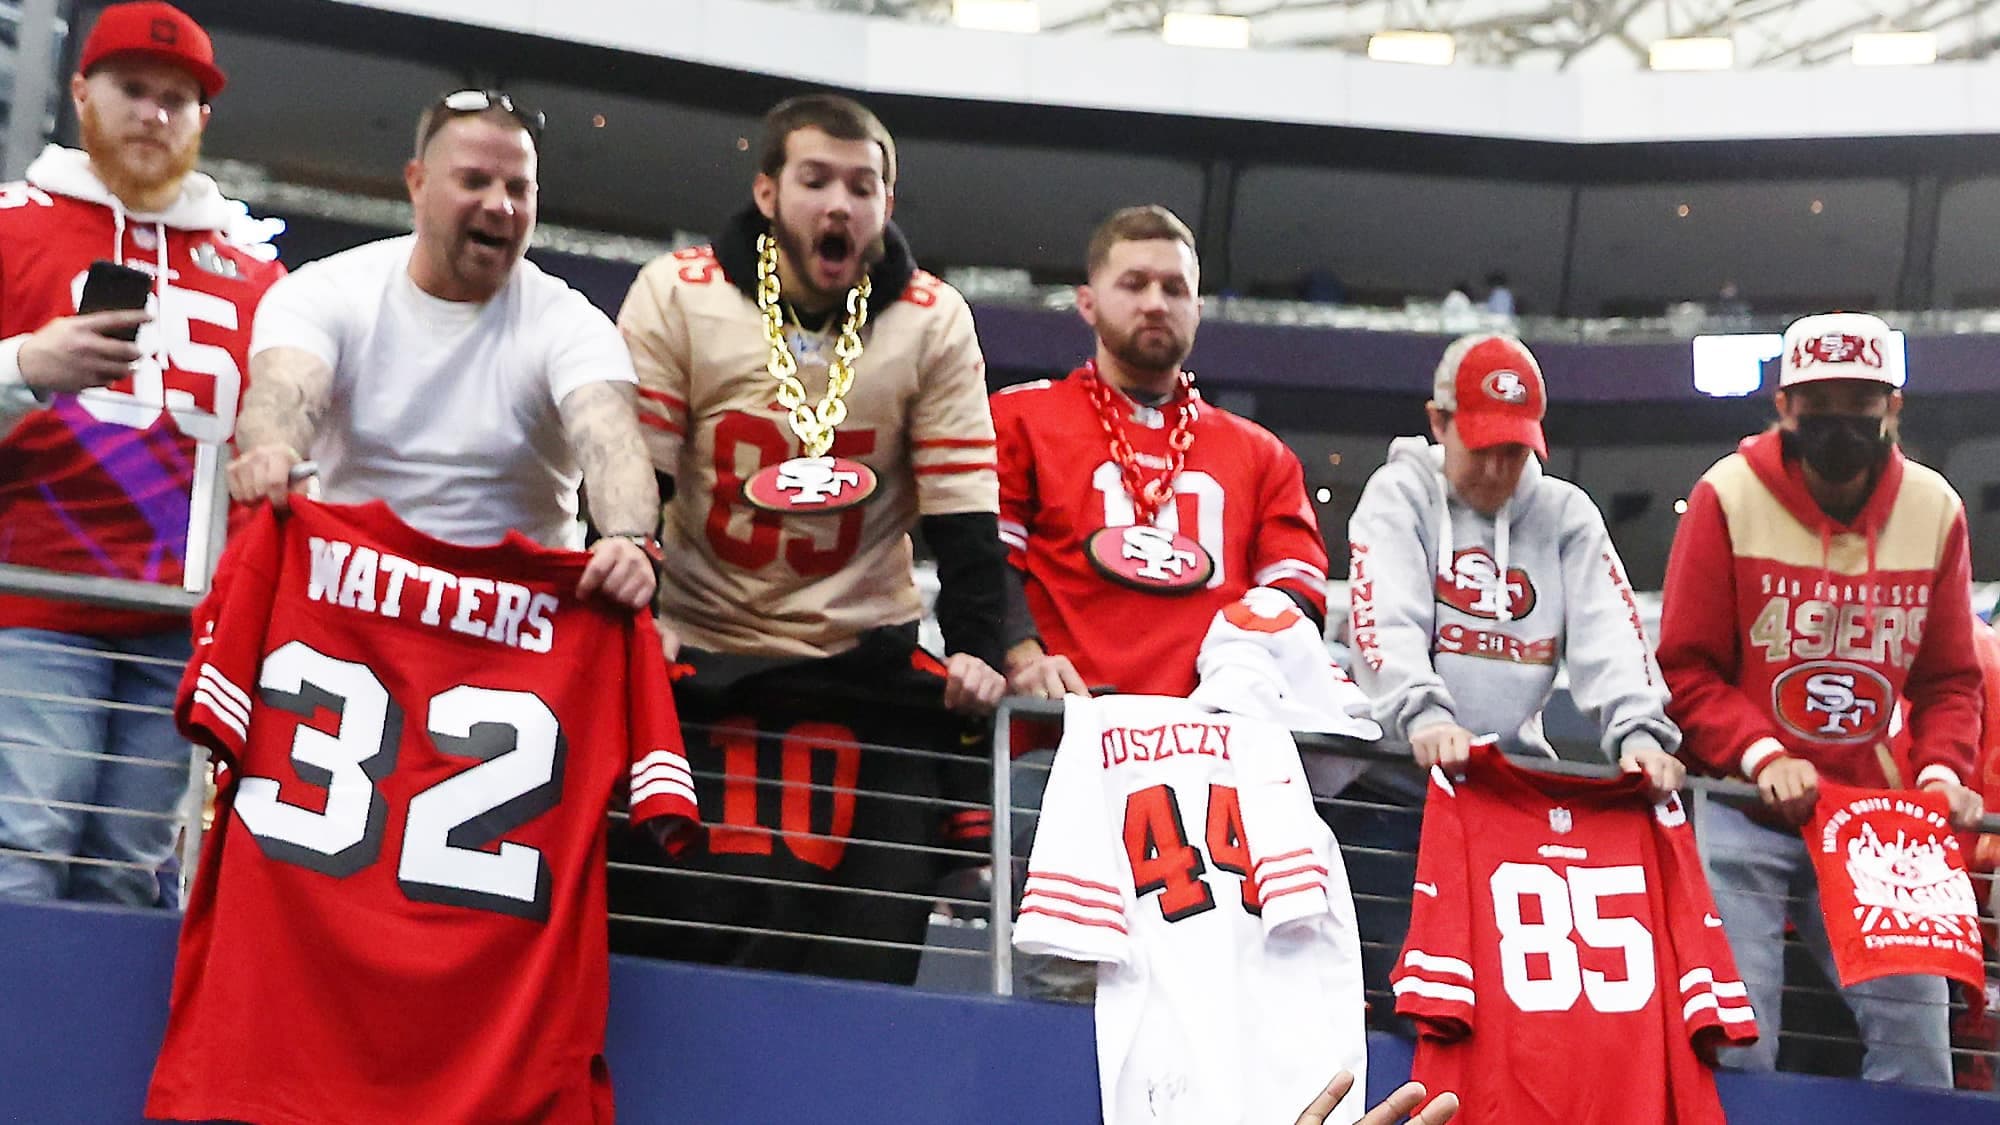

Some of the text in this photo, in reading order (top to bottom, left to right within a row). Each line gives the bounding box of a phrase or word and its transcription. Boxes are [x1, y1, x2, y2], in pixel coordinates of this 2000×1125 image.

[307, 536, 559, 654] WATTERS
[1750, 595, 1929, 672] 49ERS
[1762, 573, 1801, 598] SAN
[1806, 673, 1877, 734] SF
[233, 639, 567, 922] 32
[709, 715, 861, 871] 10
[1122, 783, 1263, 923] 44
[1490, 861, 1656, 1013] 85
